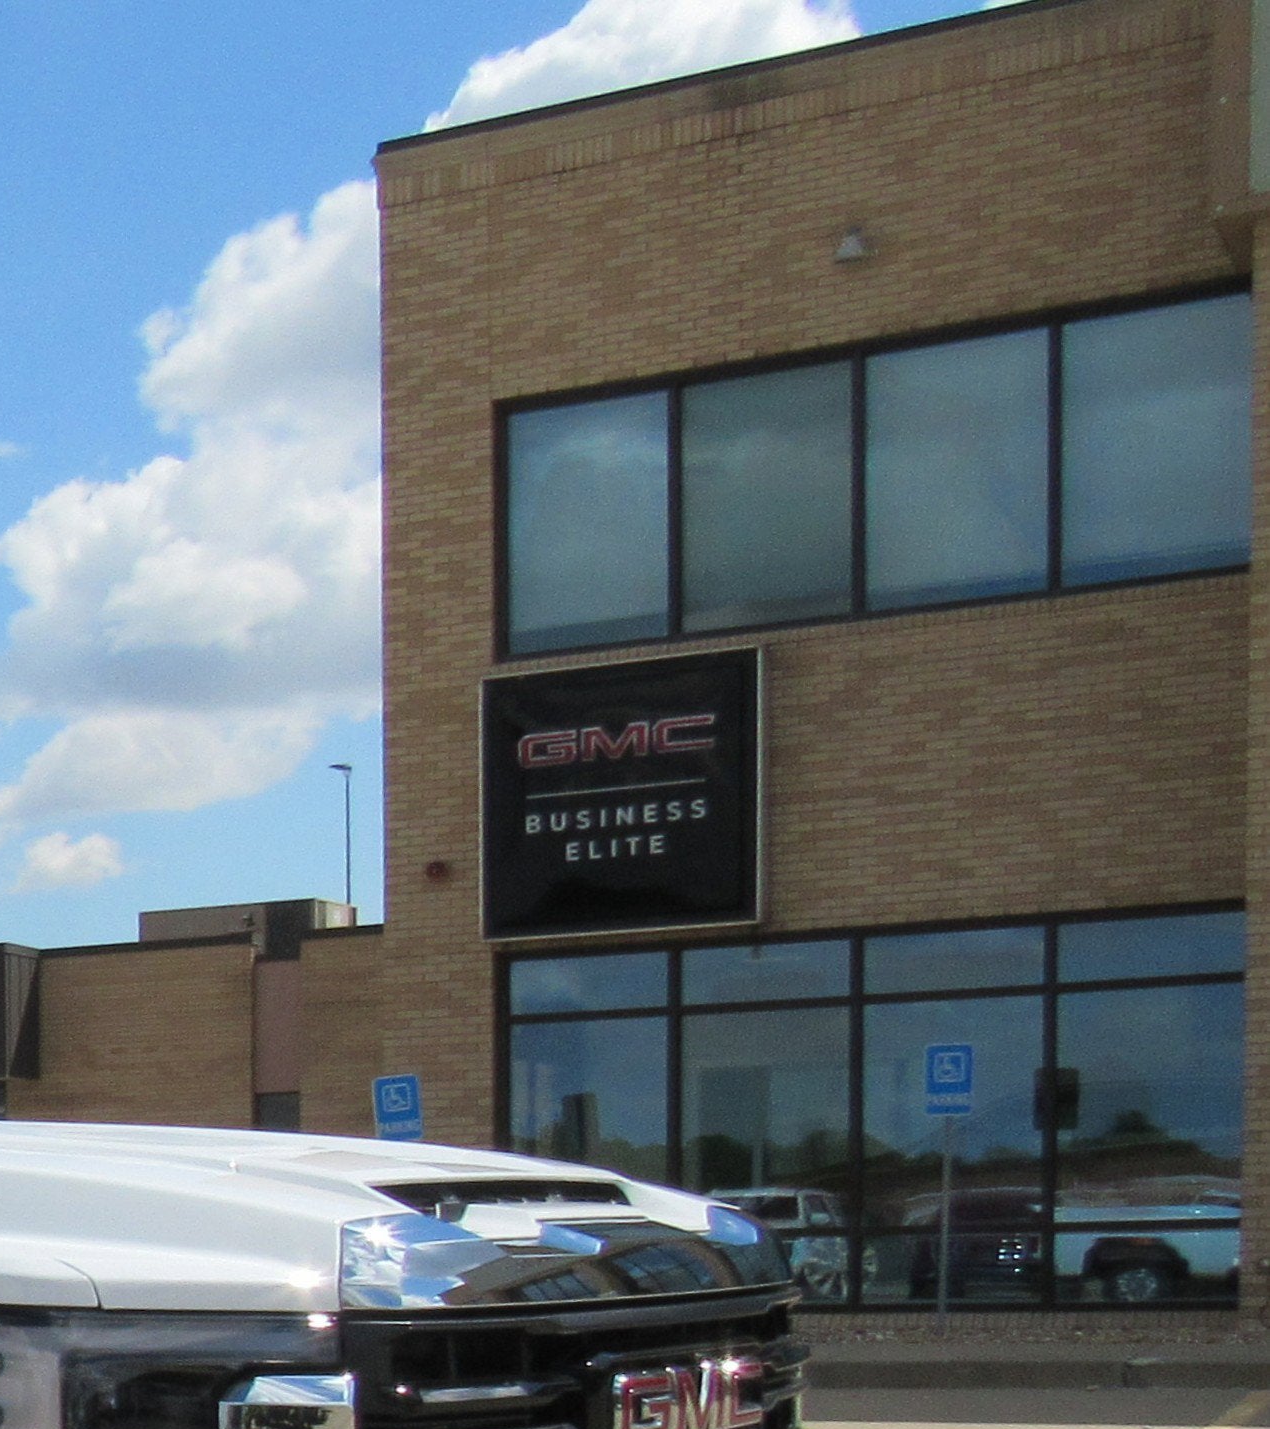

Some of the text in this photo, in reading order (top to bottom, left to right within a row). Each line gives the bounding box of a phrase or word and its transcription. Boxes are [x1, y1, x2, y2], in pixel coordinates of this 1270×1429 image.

[518, 714, 715, 769] GMC
[525, 799, 707, 834] BUSINESS
[565, 835, 665, 861] ELITE
